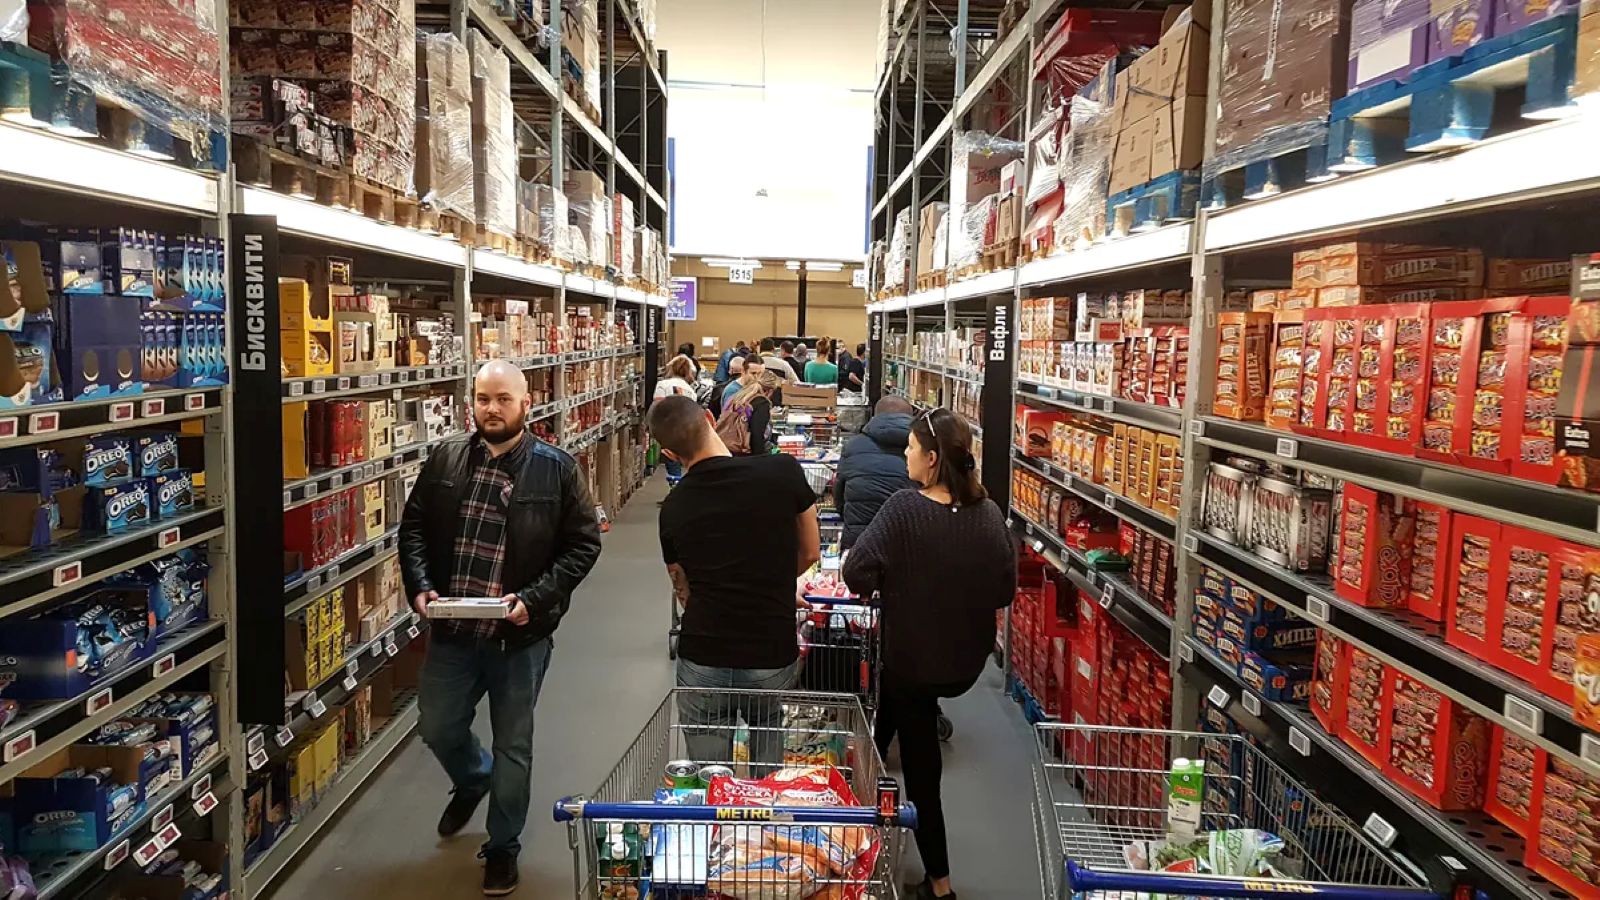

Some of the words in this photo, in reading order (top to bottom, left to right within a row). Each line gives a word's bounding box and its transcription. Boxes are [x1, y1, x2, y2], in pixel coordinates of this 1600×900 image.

[241, 234, 266, 370] Бисквити
[989, 305, 1010, 361] Вафли
[86, 447, 123, 473] OREO
[144, 442, 173, 465] OREO
[109, 491, 143, 517] OREO
[160, 480, 188, 503] OREO
[34, 810, 77, 824] OREO
[112, 806, 135, 833] OREO
[716, 807, 774, 820] METRO
